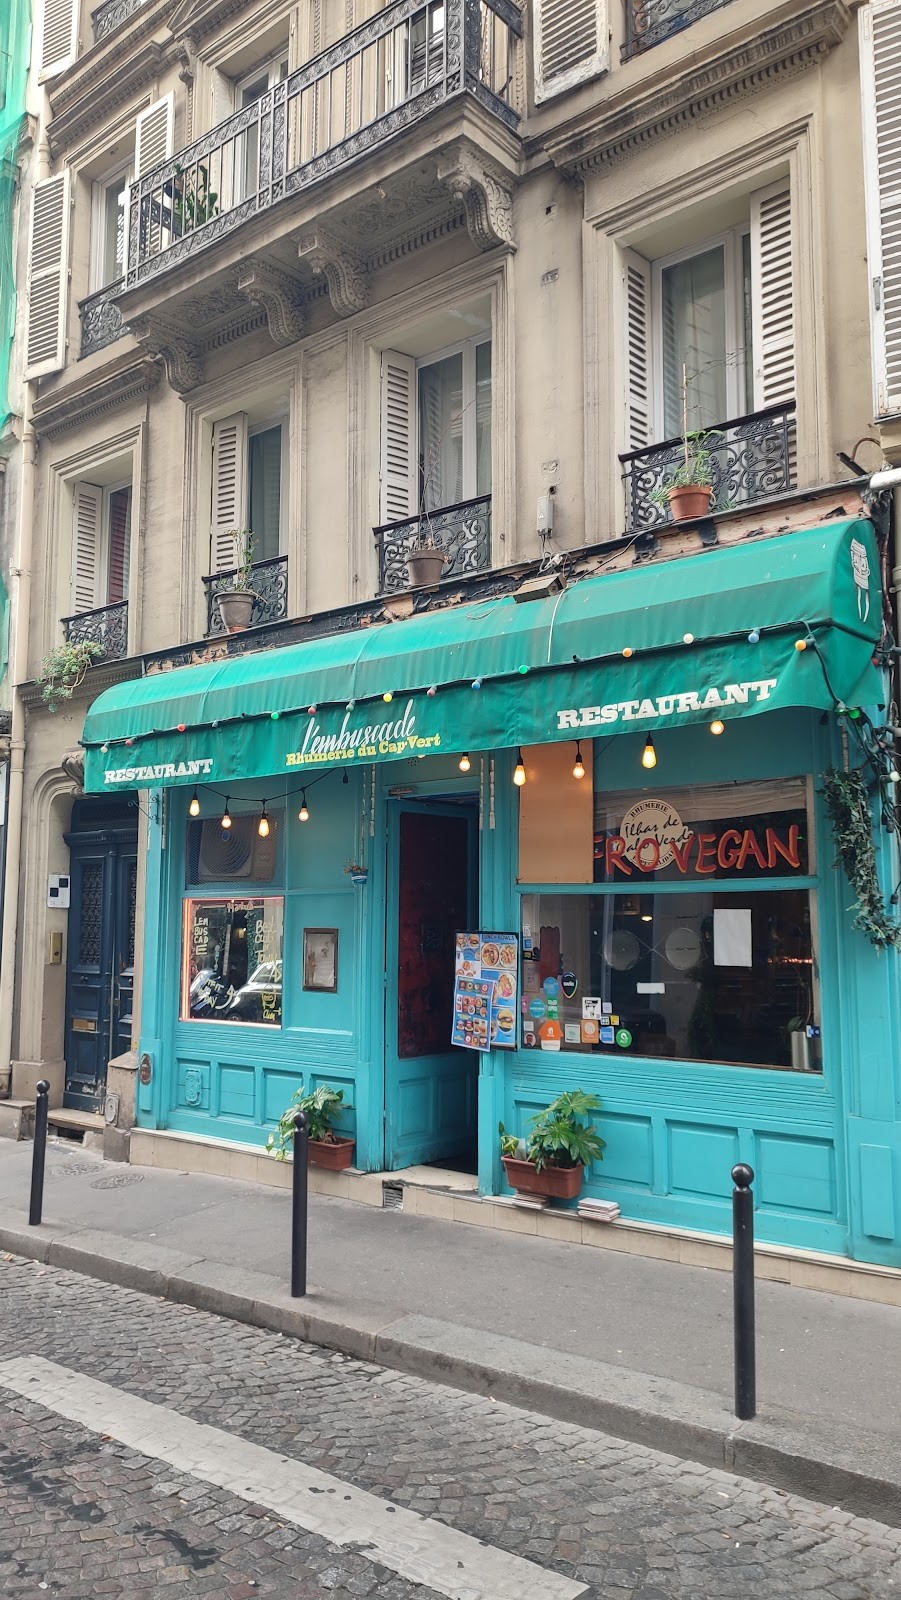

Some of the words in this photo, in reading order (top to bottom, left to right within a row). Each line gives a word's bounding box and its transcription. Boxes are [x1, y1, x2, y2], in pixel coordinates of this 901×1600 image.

[556, 678, 777, 730] RESTAURANT
[285, 747, 355, 766] Rhumerie
[358, 743, 377, 757] du
[104, 758, 213, 784] RESTAURANT
[630, 802, 669, 818] RHUMERIE
[663, 814, 680, 829] de
[670, 824, 801, 875] VEGAN
[194, 927, 208, 936] BUS
